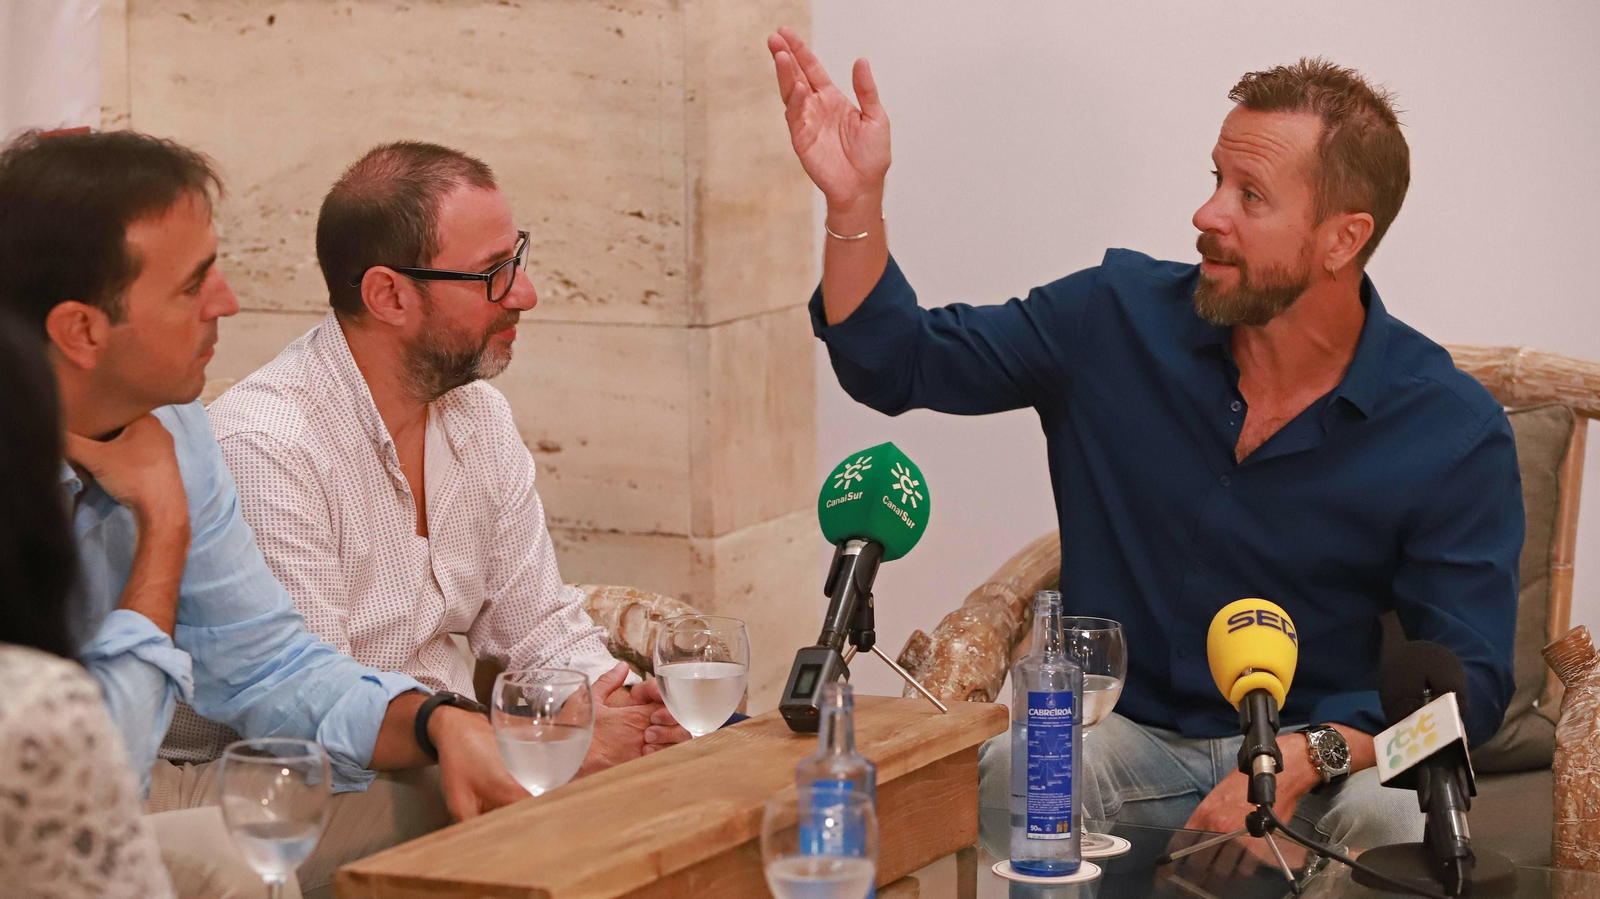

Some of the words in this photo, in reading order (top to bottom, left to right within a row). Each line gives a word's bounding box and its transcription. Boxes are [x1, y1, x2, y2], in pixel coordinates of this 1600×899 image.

[826, 491, 863, 508] CanalSur
[882, 495, 915, 529] CanalSur
[1227, 609, 1297, 648] SER
